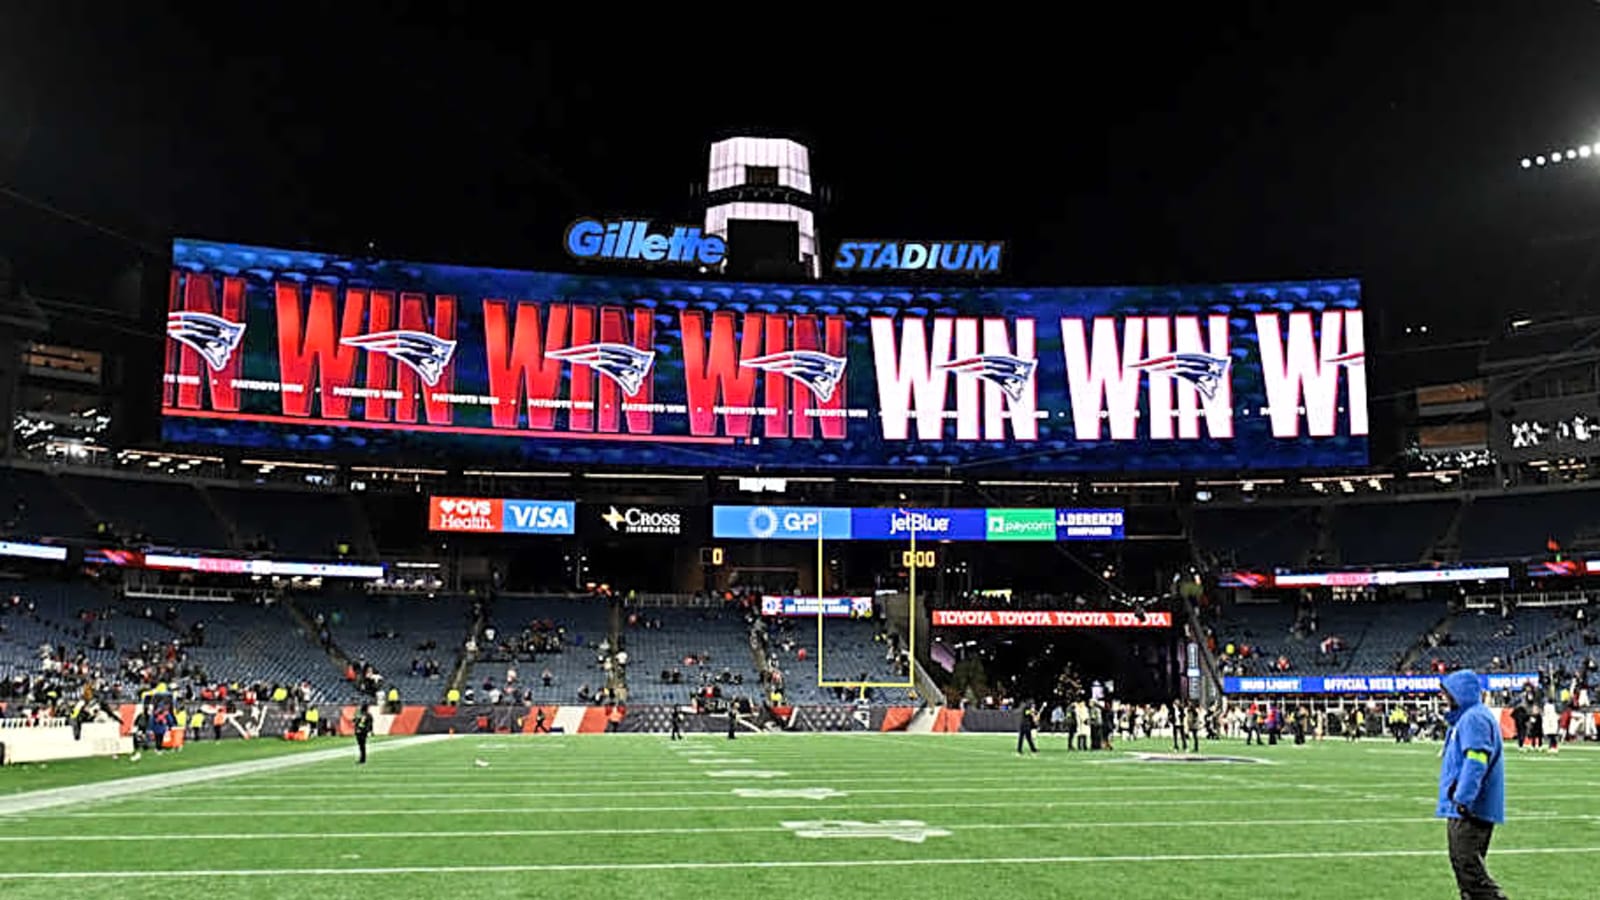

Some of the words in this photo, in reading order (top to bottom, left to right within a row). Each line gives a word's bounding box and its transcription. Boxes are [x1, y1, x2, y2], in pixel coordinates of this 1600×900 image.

[567, 219, 727, 264] Gillette
[835, 241, 1001, 271] STADIUM
[275, 281, 456, 425] WIN
[483, 299, 654, 433] WIN
[681, 310, 847, 439] WIN
[870, 315, 1038, 441] WIN
[1061, 314, 1234, 440] WIN
[231, 379, 280, 392] PATRIOTS
[333, 386, 380, 399] PATRIOTS
[432, 393, 478, 404] PATRIOTS
[528, 398, 572, 409] PATRIOTS
[622, 402, 665, 413] PATRIOTS
[713, 406, 756, 416] PATRIOTS
[804, 408, 847, 418] PATRIOTS
[456, 500, 491, 515] CVS
[509, 505, 569, 528] VISA
[784, 513, 818, 531] GP
[890, 513, 950, 534] jetBlue
[626, 525, 681, 534] INSURANCE
[1005, 519, 1055, 535] paycom
[712, 548, 723, 565] 0
[939, 610, 993, 626] TOYOTA
[999, 611, 1052, 626] TOYOTA
[1057, 611, 1110, 627] TOYOTA
[1241, 679, 1265, 691] BUD
[1266, 679, 1299, 691] LIGHT
[1324, 677, 1368, 692] OFFICIAL
[1370, 677, 1393, 691] BEER
[1489, 677, 1511, 688] BUD
